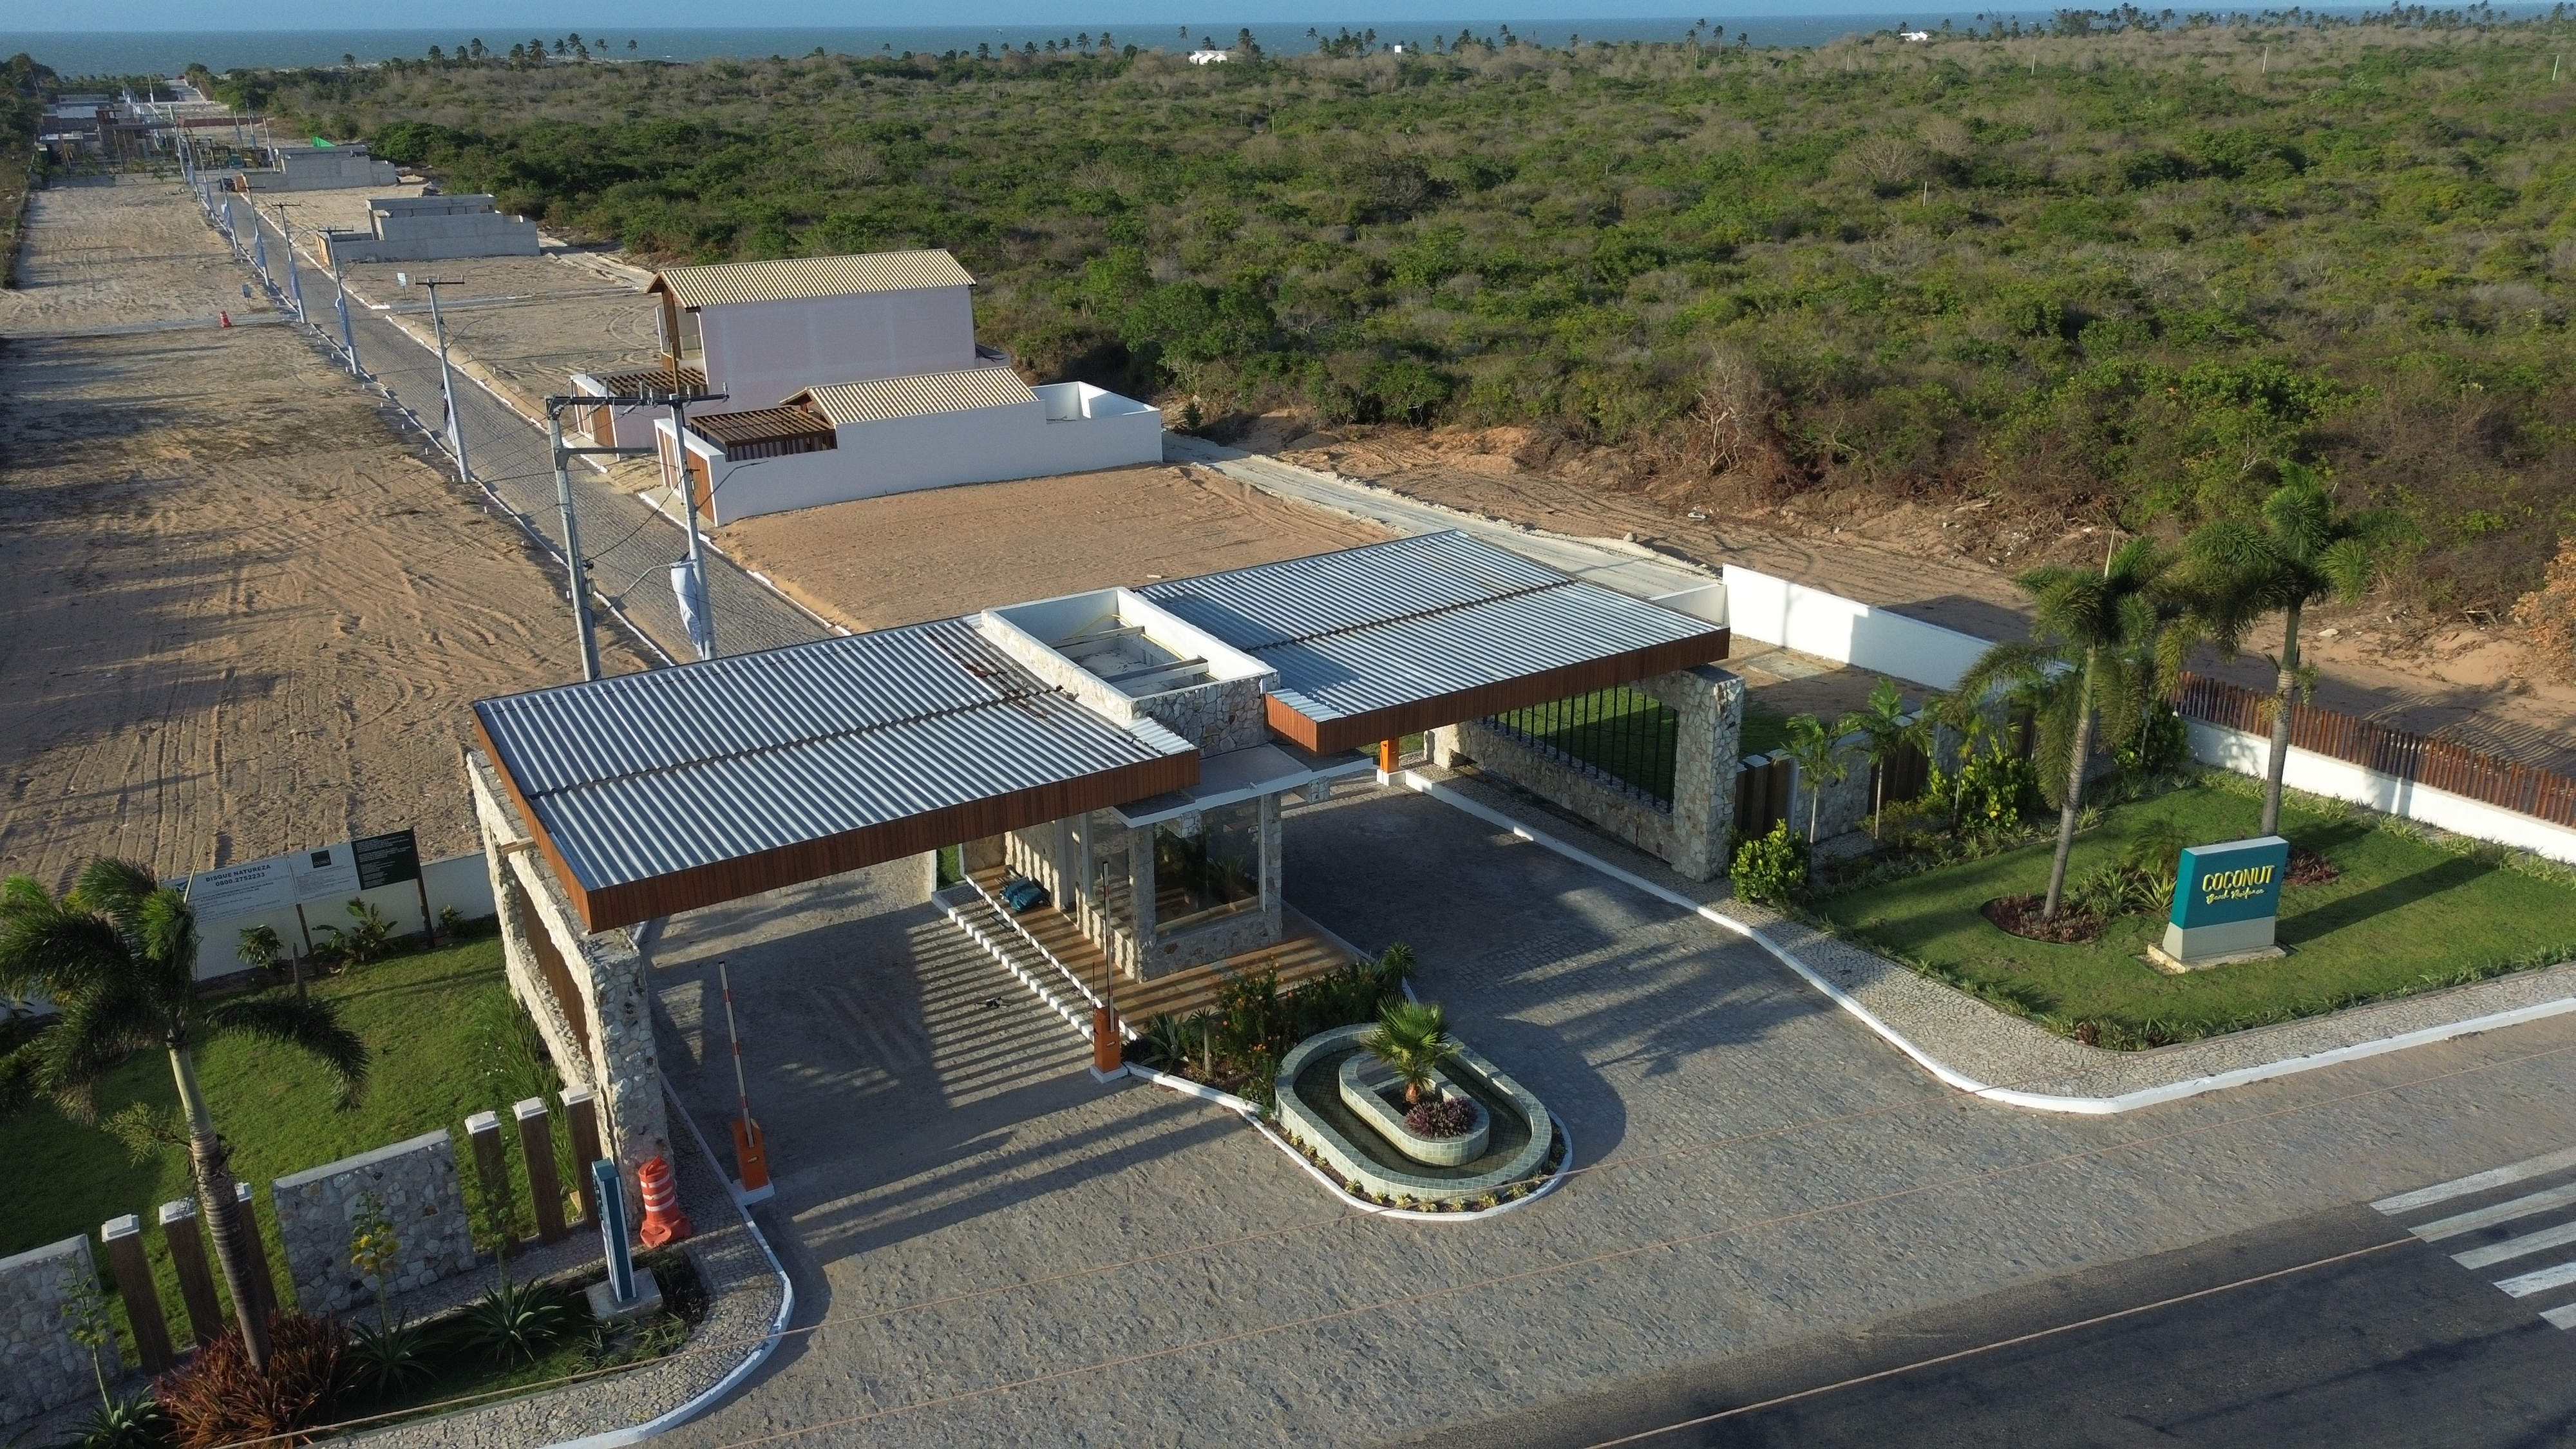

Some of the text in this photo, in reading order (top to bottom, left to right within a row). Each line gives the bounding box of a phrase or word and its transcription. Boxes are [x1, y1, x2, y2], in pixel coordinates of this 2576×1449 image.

[205, 864, 271, 882] DISQUE NATUREZA
[2202, 865, 2275, 892] COCONUT
